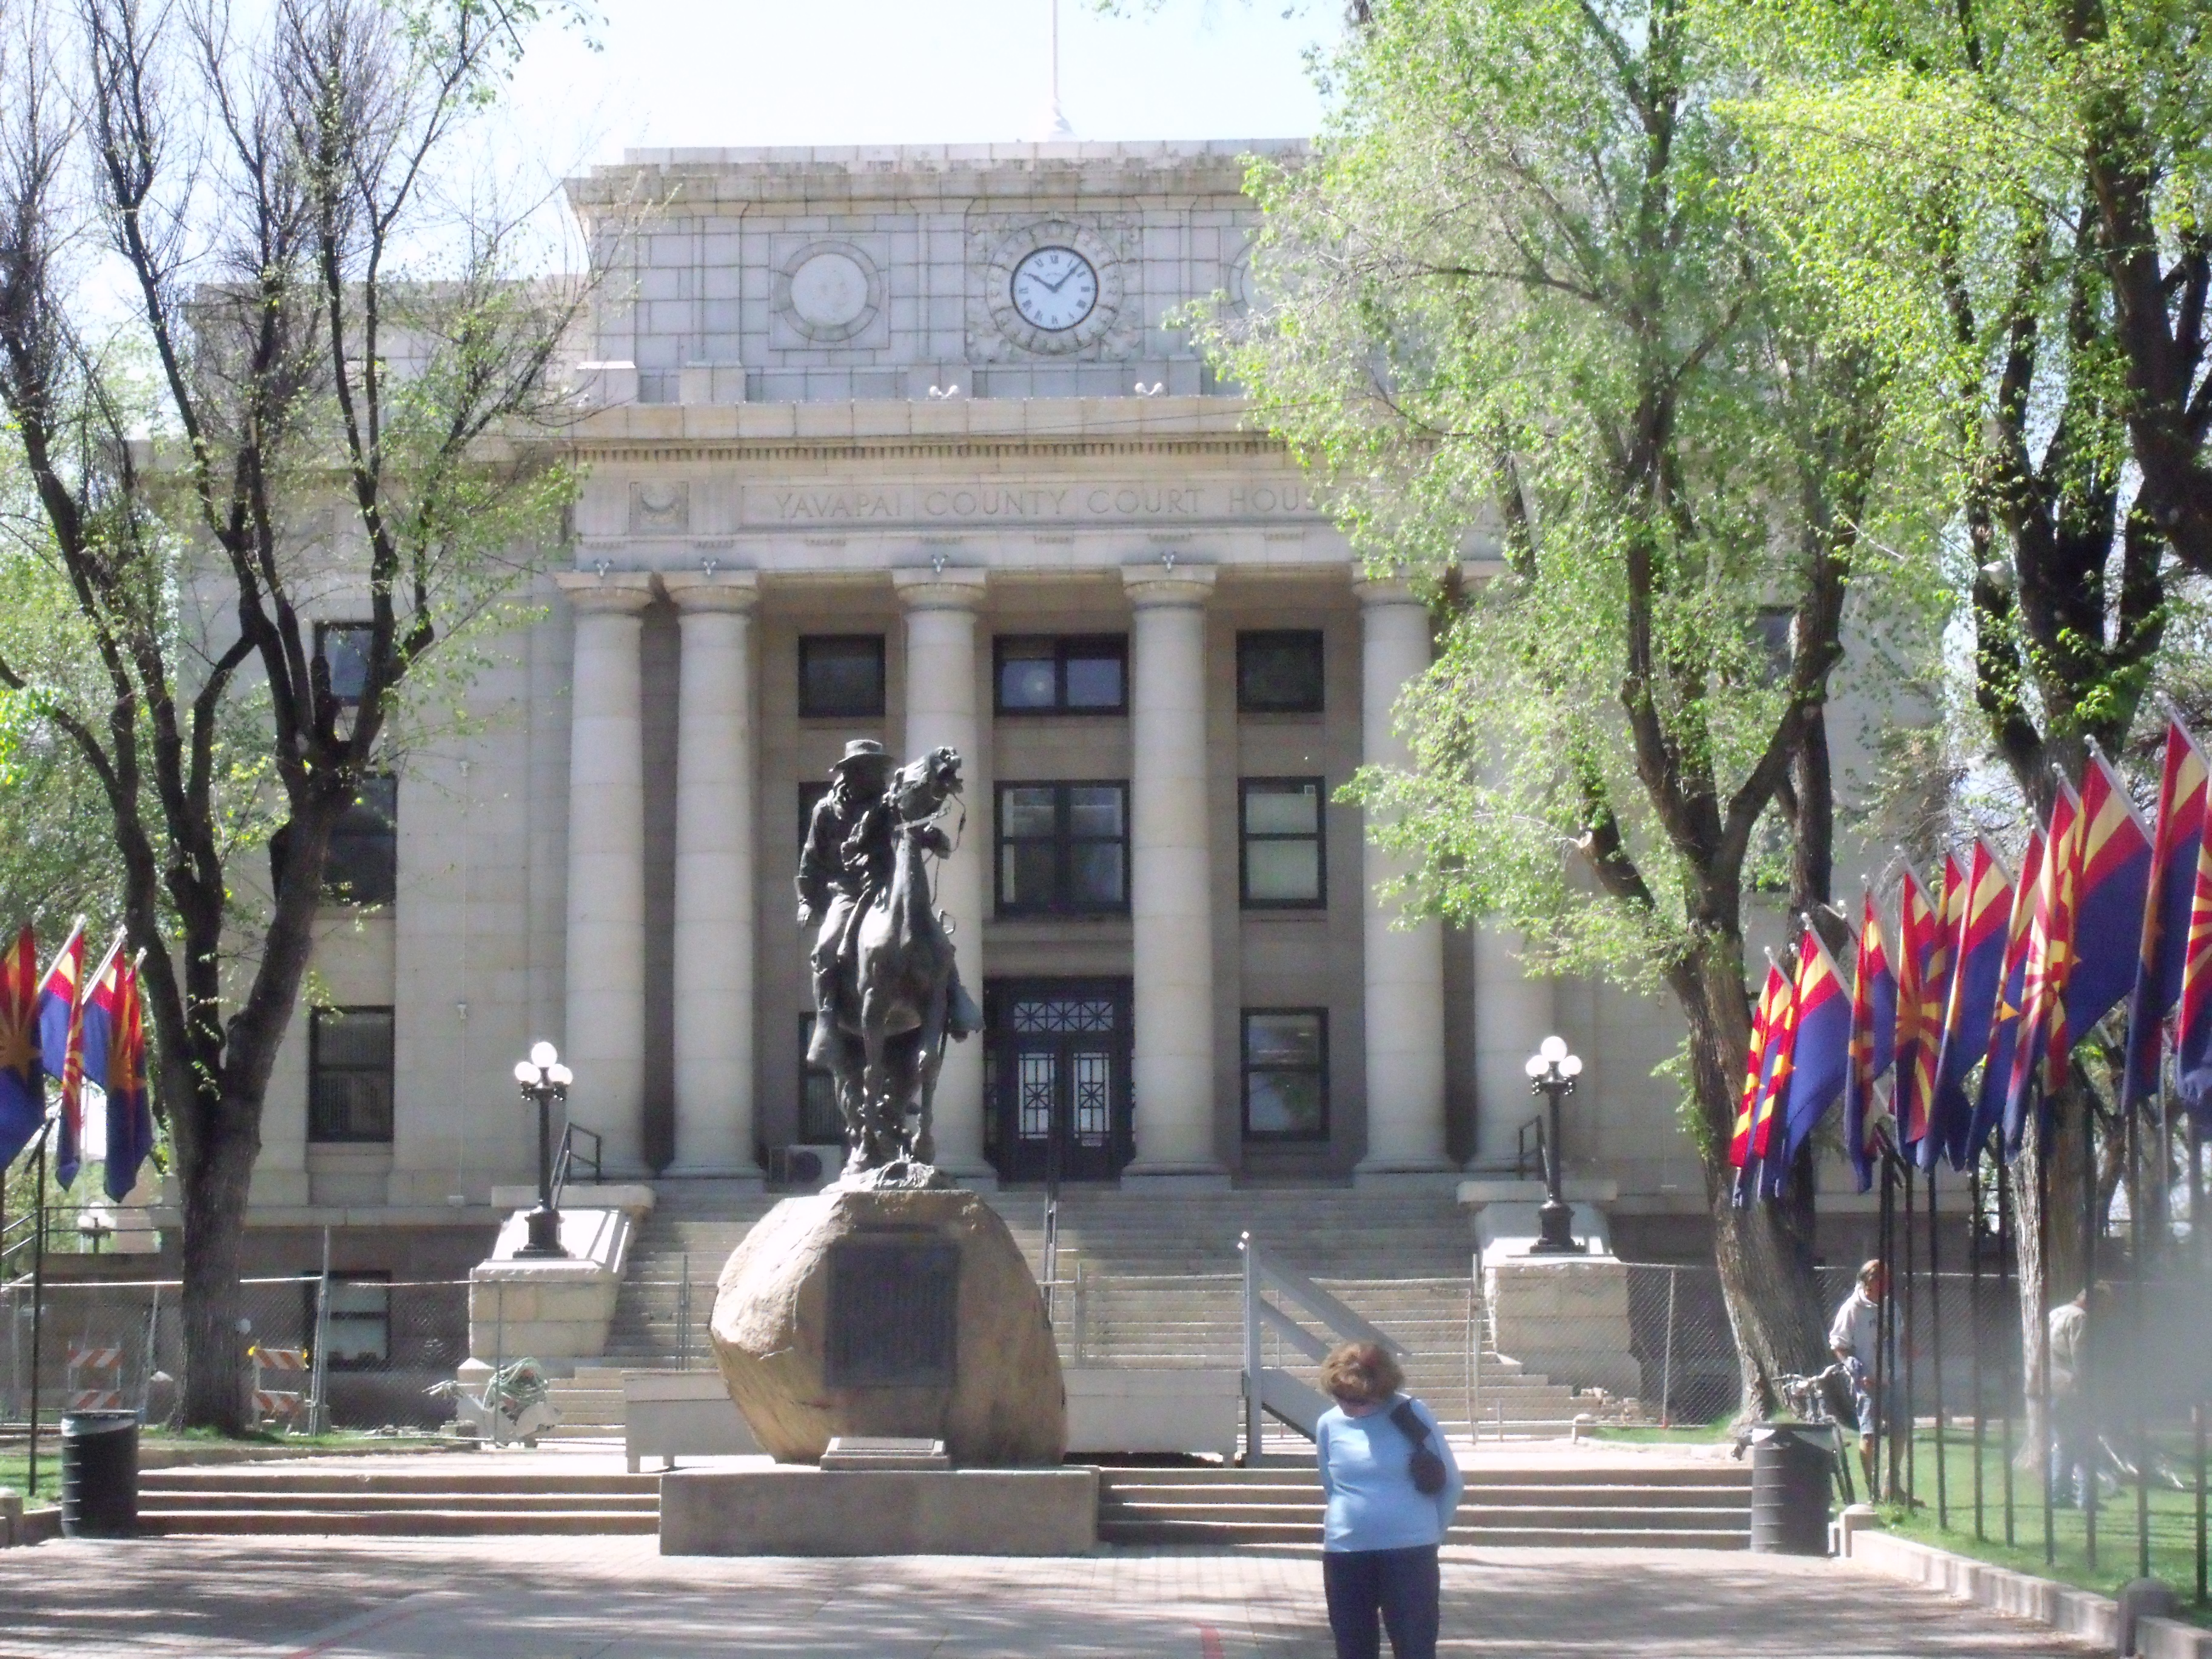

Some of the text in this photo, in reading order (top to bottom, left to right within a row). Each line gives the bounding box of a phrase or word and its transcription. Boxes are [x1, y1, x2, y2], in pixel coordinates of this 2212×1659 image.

[774, 492, 903, 519] YAVAPAI
[925, 489, 1069, 516] COUNTY
[1087, 488, 1205, 514] COURT
